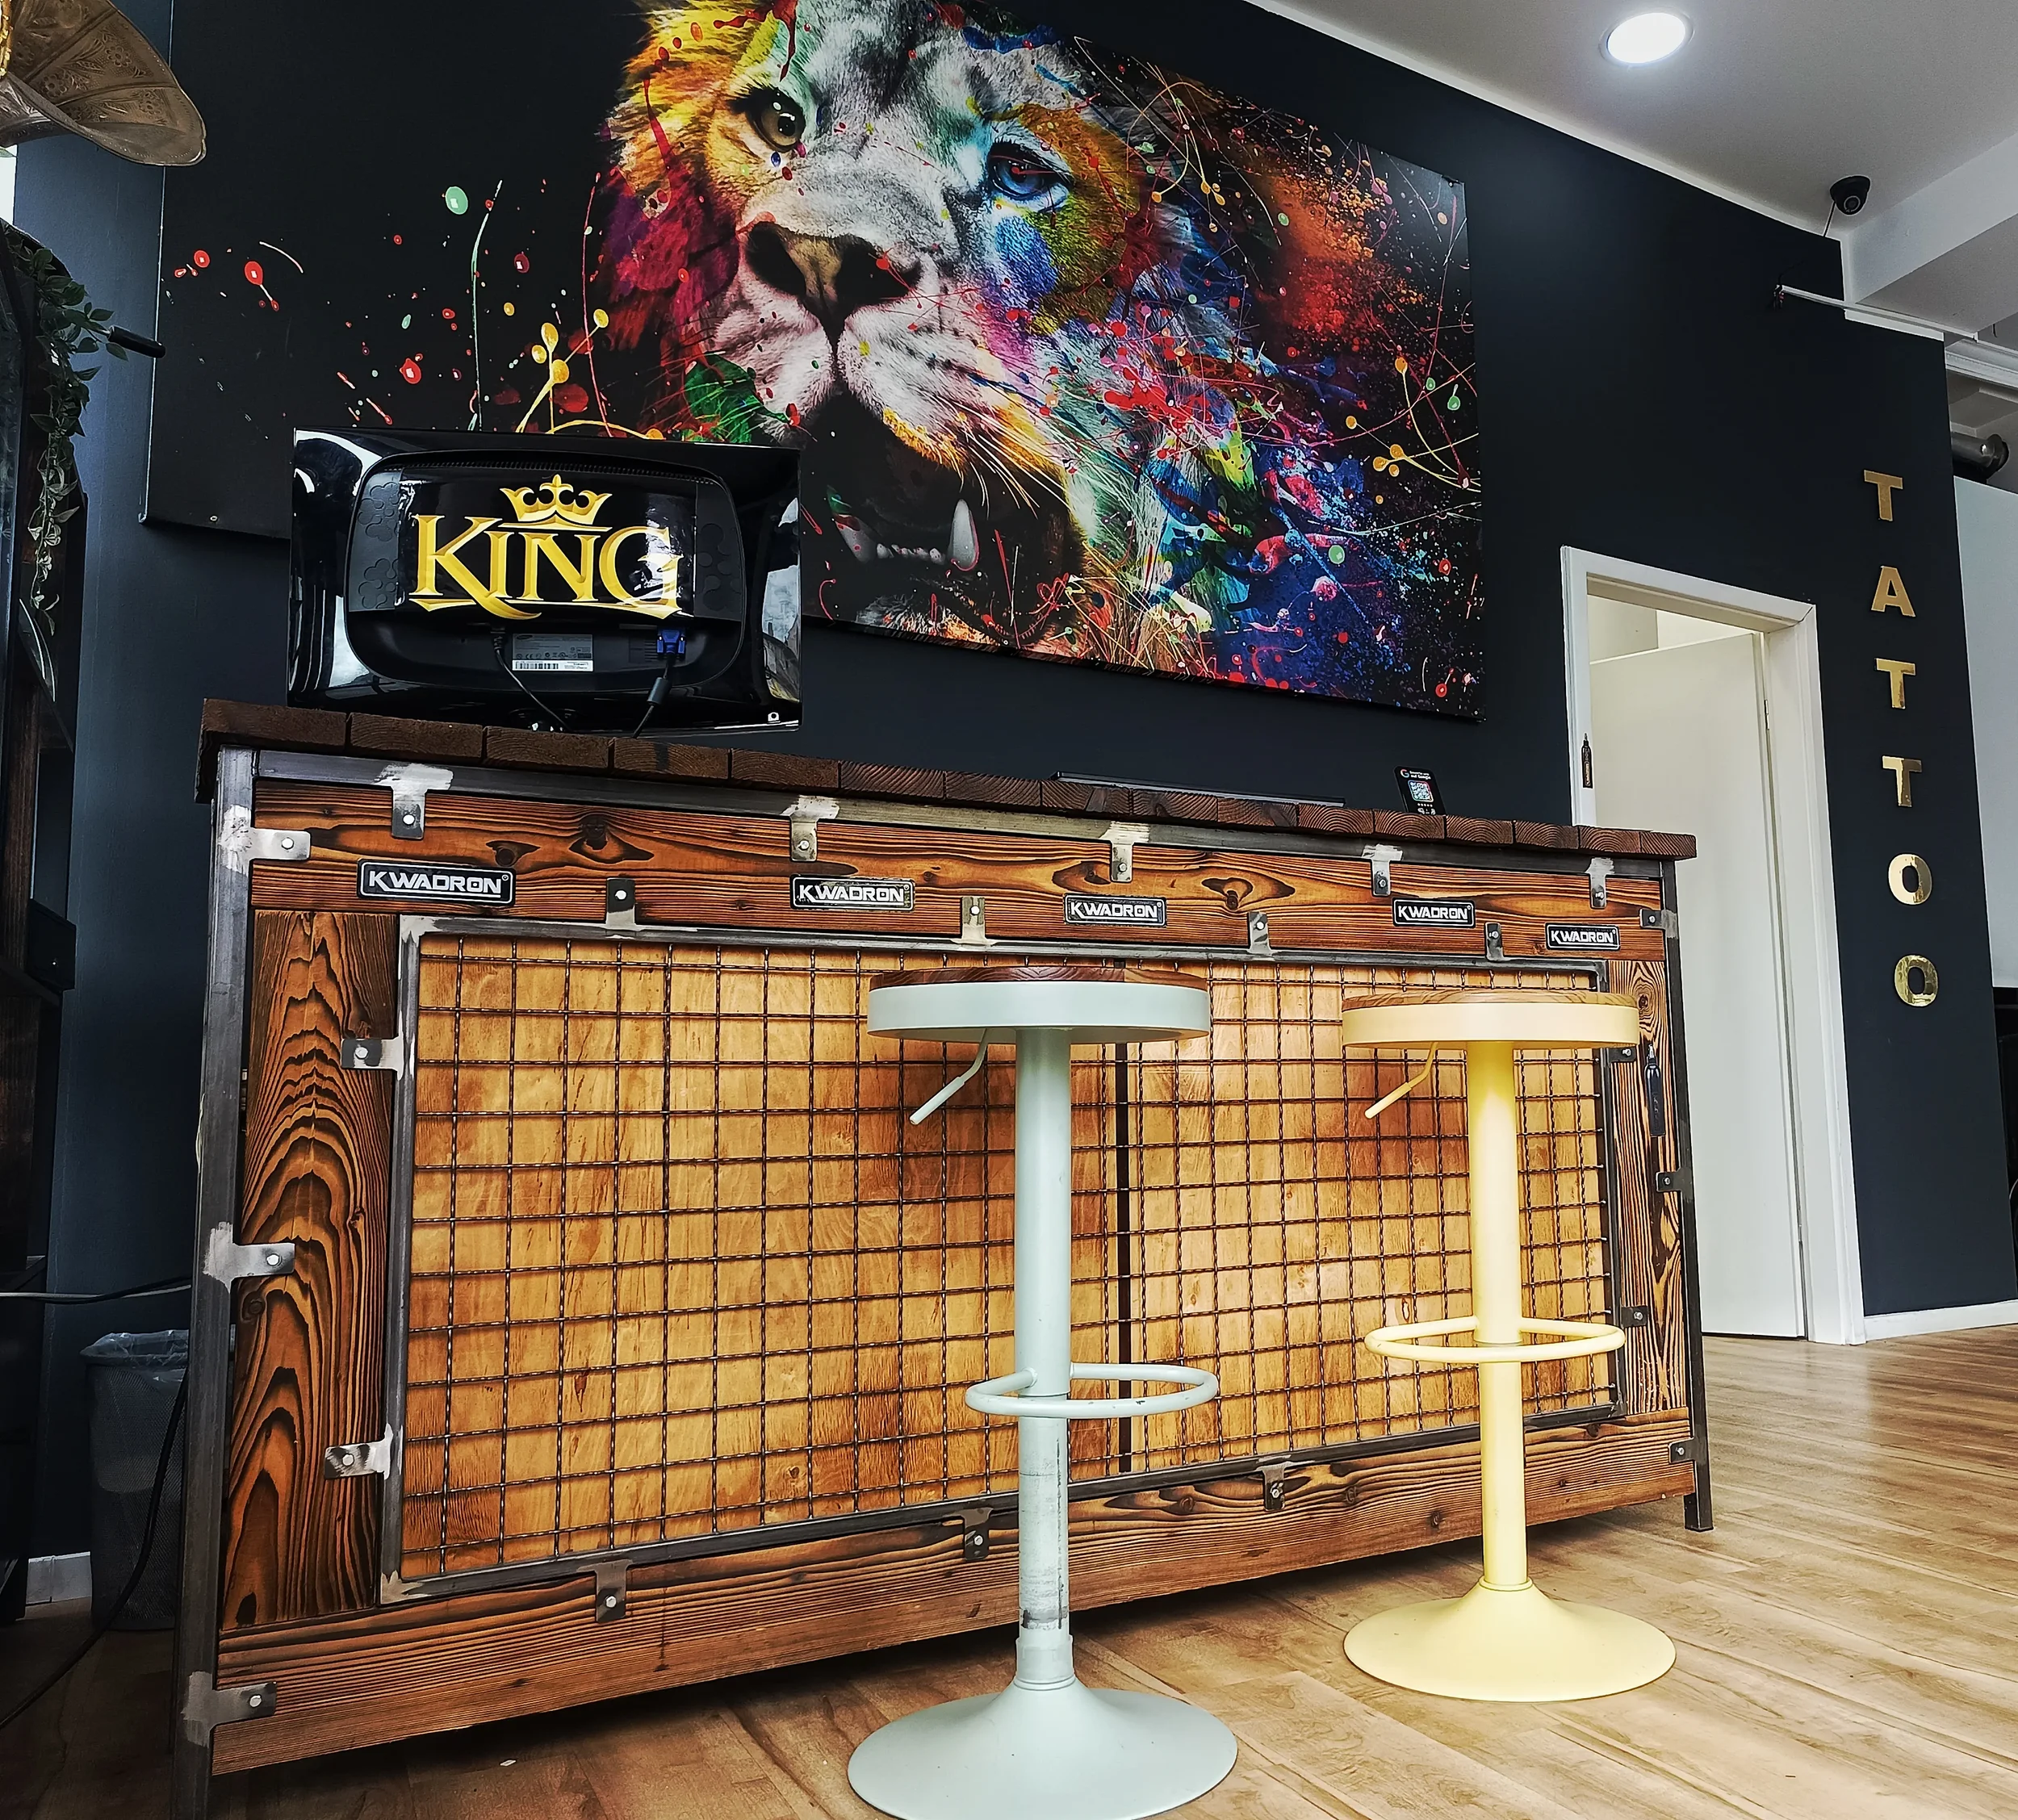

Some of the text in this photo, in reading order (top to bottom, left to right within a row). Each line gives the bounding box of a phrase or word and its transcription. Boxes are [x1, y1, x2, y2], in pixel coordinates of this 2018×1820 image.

[407, 515, 685, 620] KING
[1863, 469, 1940, 1007] TATTOO
[369, 870, 501, 898] KWADRON
[798, 885, 904, 906] KWADRON
[1070, 902, 1158, 922] KWADRON
[1397, 905, 1468, 923] KWADRON
[1551, 930, 1614, 946] KWADRON
